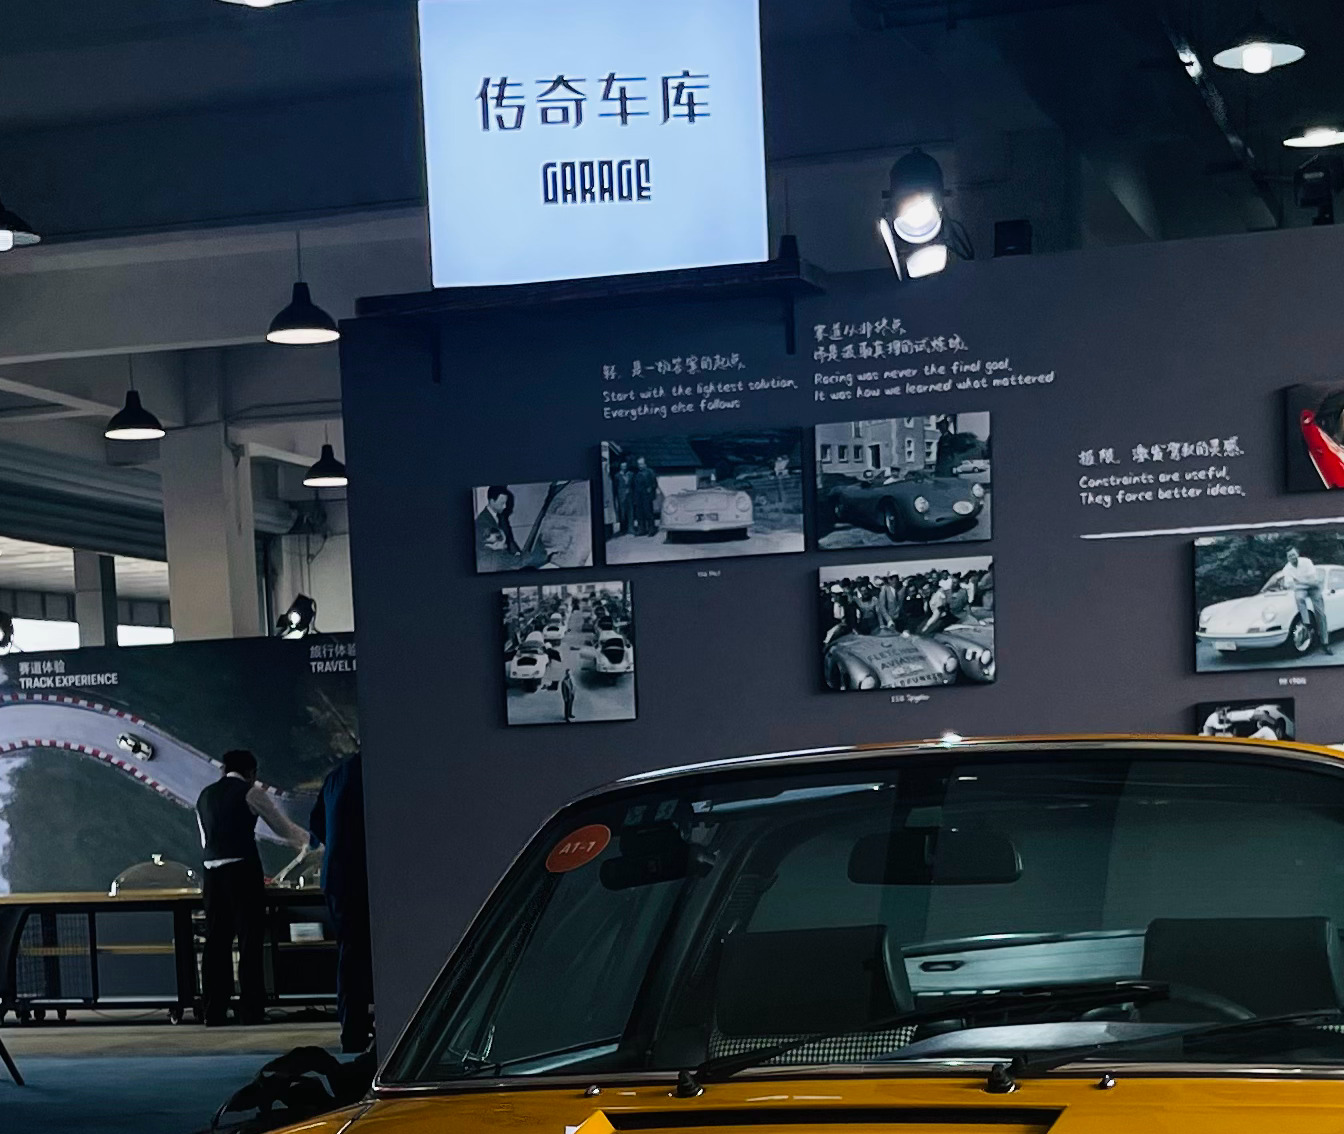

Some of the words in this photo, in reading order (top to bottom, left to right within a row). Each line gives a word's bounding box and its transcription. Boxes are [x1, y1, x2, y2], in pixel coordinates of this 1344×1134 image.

[474, 69, 711, 131] 传奇车库
[543, 158, 652, 205] GARAGE
[814, 371, 853, 387] Racing
[856, 371, 879, 381] was
[883, 368, 918, 380] never
[924, 363, 946, 376] the
[951, 359, 981, 374] final
[602, 390, 635, 403] Start
[639, 387, 664, 400] with
[671, 385, 692, 397] the
[697, 380, 743, 399] lightest
[814, 390, 825, 401] It
[829, 390, 852, 400] was
[856, 386, 880, 398] how
[884, 386, 901, 396] we
[905, 379, 952, 394] learned
[956, 377, 988, 390] what
[602, 403, 667, 421] Everything
[671, 400, 694, 413] else
[1078, 473, 1154, 488] Constraints
[1159, 471, 1179, 482] are
[1184, 466, 1230, 481] useful.
[1080, 492, 1111, 508] They
[1116, 489, 1153, 503] force
[1158, 486, 1202, 500] better
[18, 660, 65, 675] 赛道体验
[310, 660, 351, 673] TRAVEL
[18, 676, 55, 689] TRACK
[55, 672, 119, 688] EXPERIENCE
